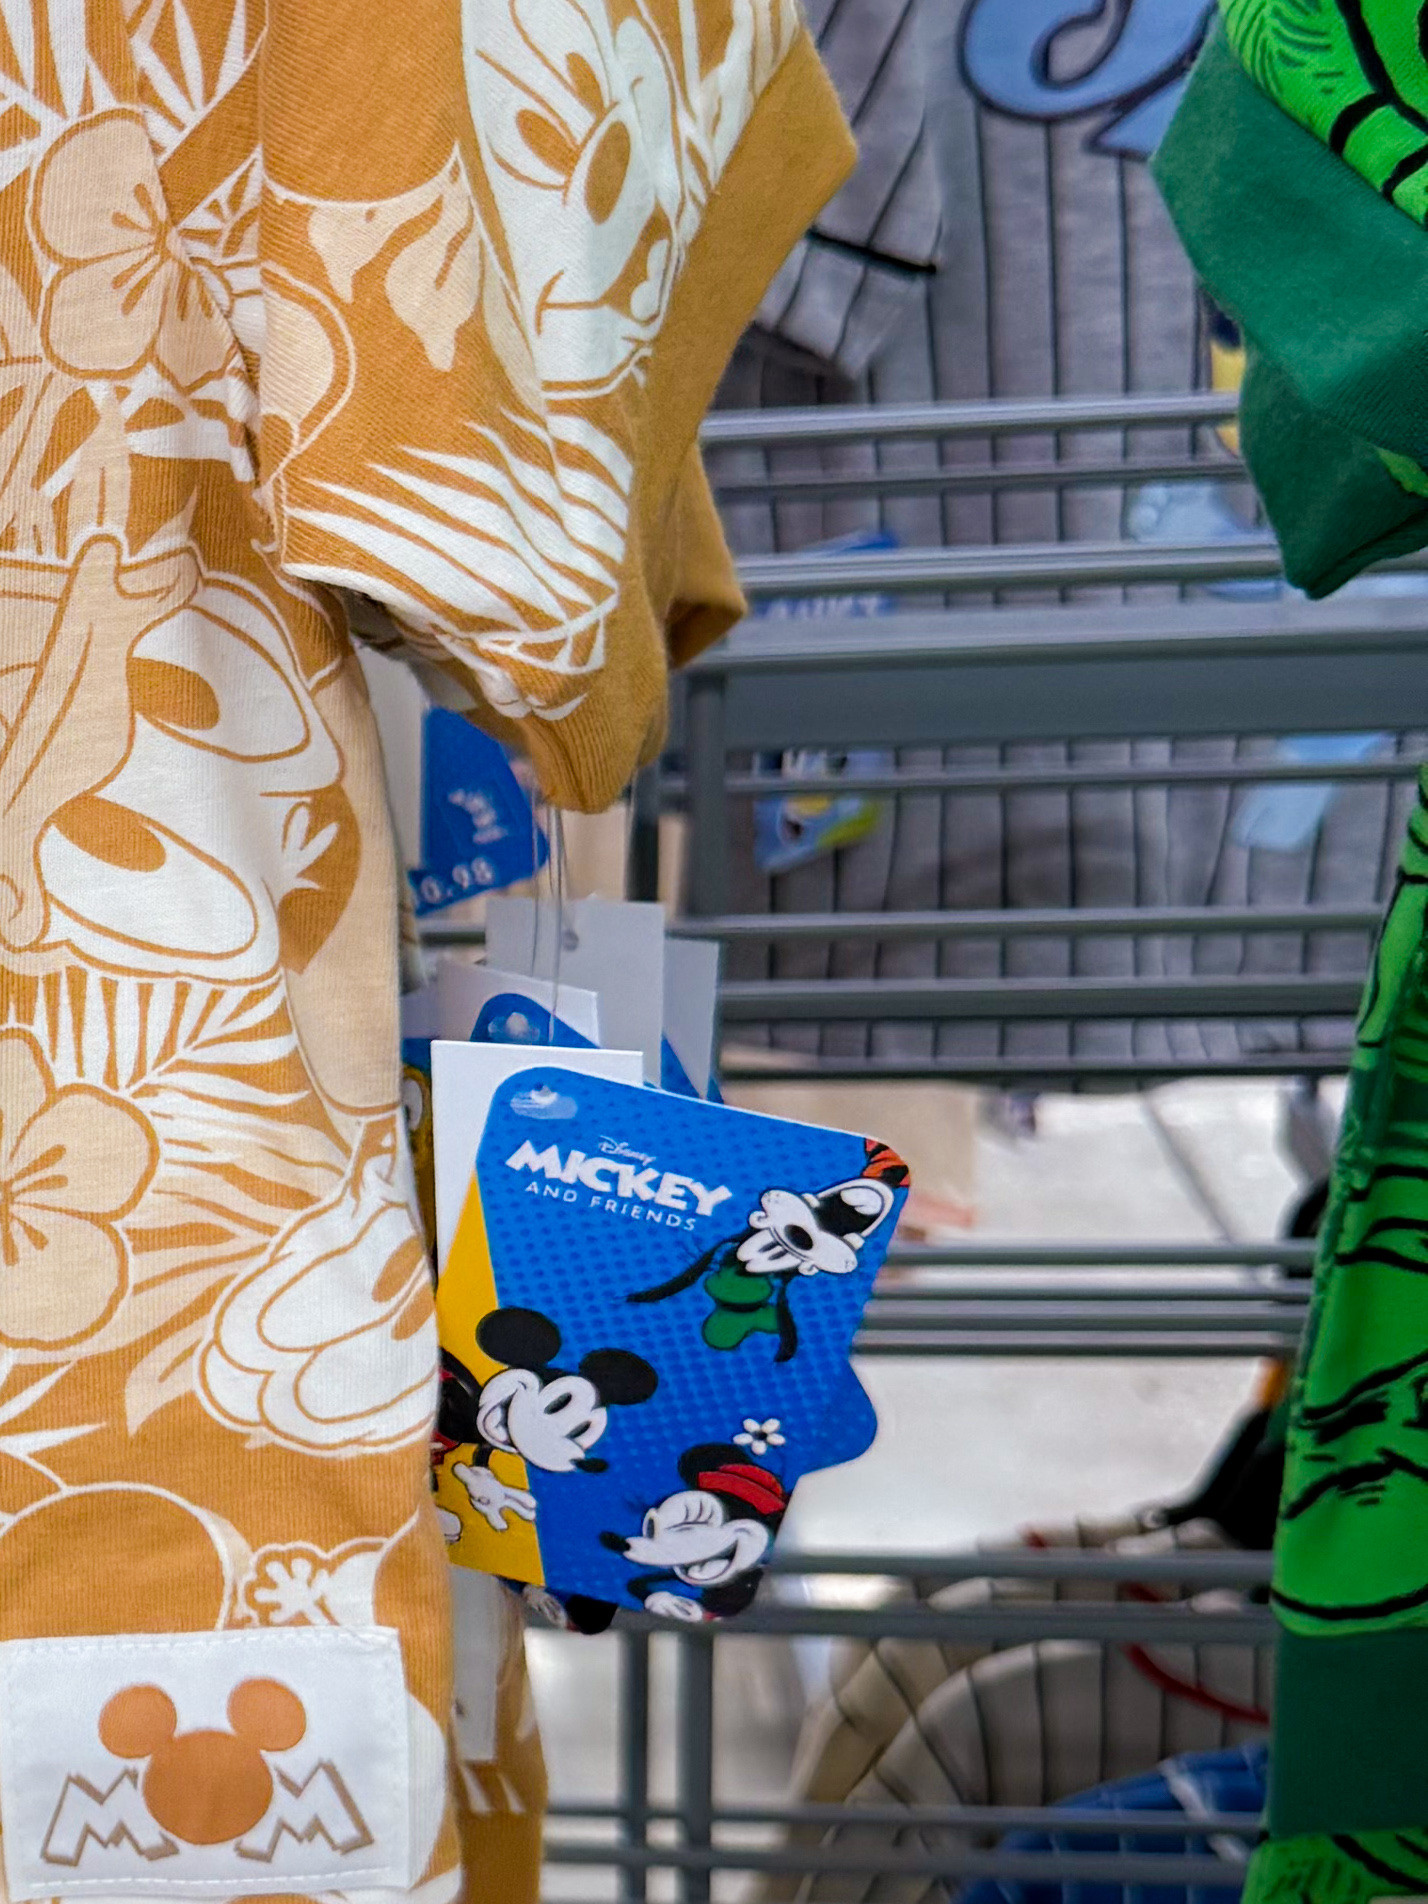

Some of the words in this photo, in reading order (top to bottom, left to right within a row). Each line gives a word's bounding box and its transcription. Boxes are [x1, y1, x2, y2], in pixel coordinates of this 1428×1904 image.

[599, 1135, 656, 1166] Disney
[505, 1139, 733, 1217] MICKEY
[525, 1180, 578, 1203] AND
[589, 1195, 697, 1232] FRIENDS
